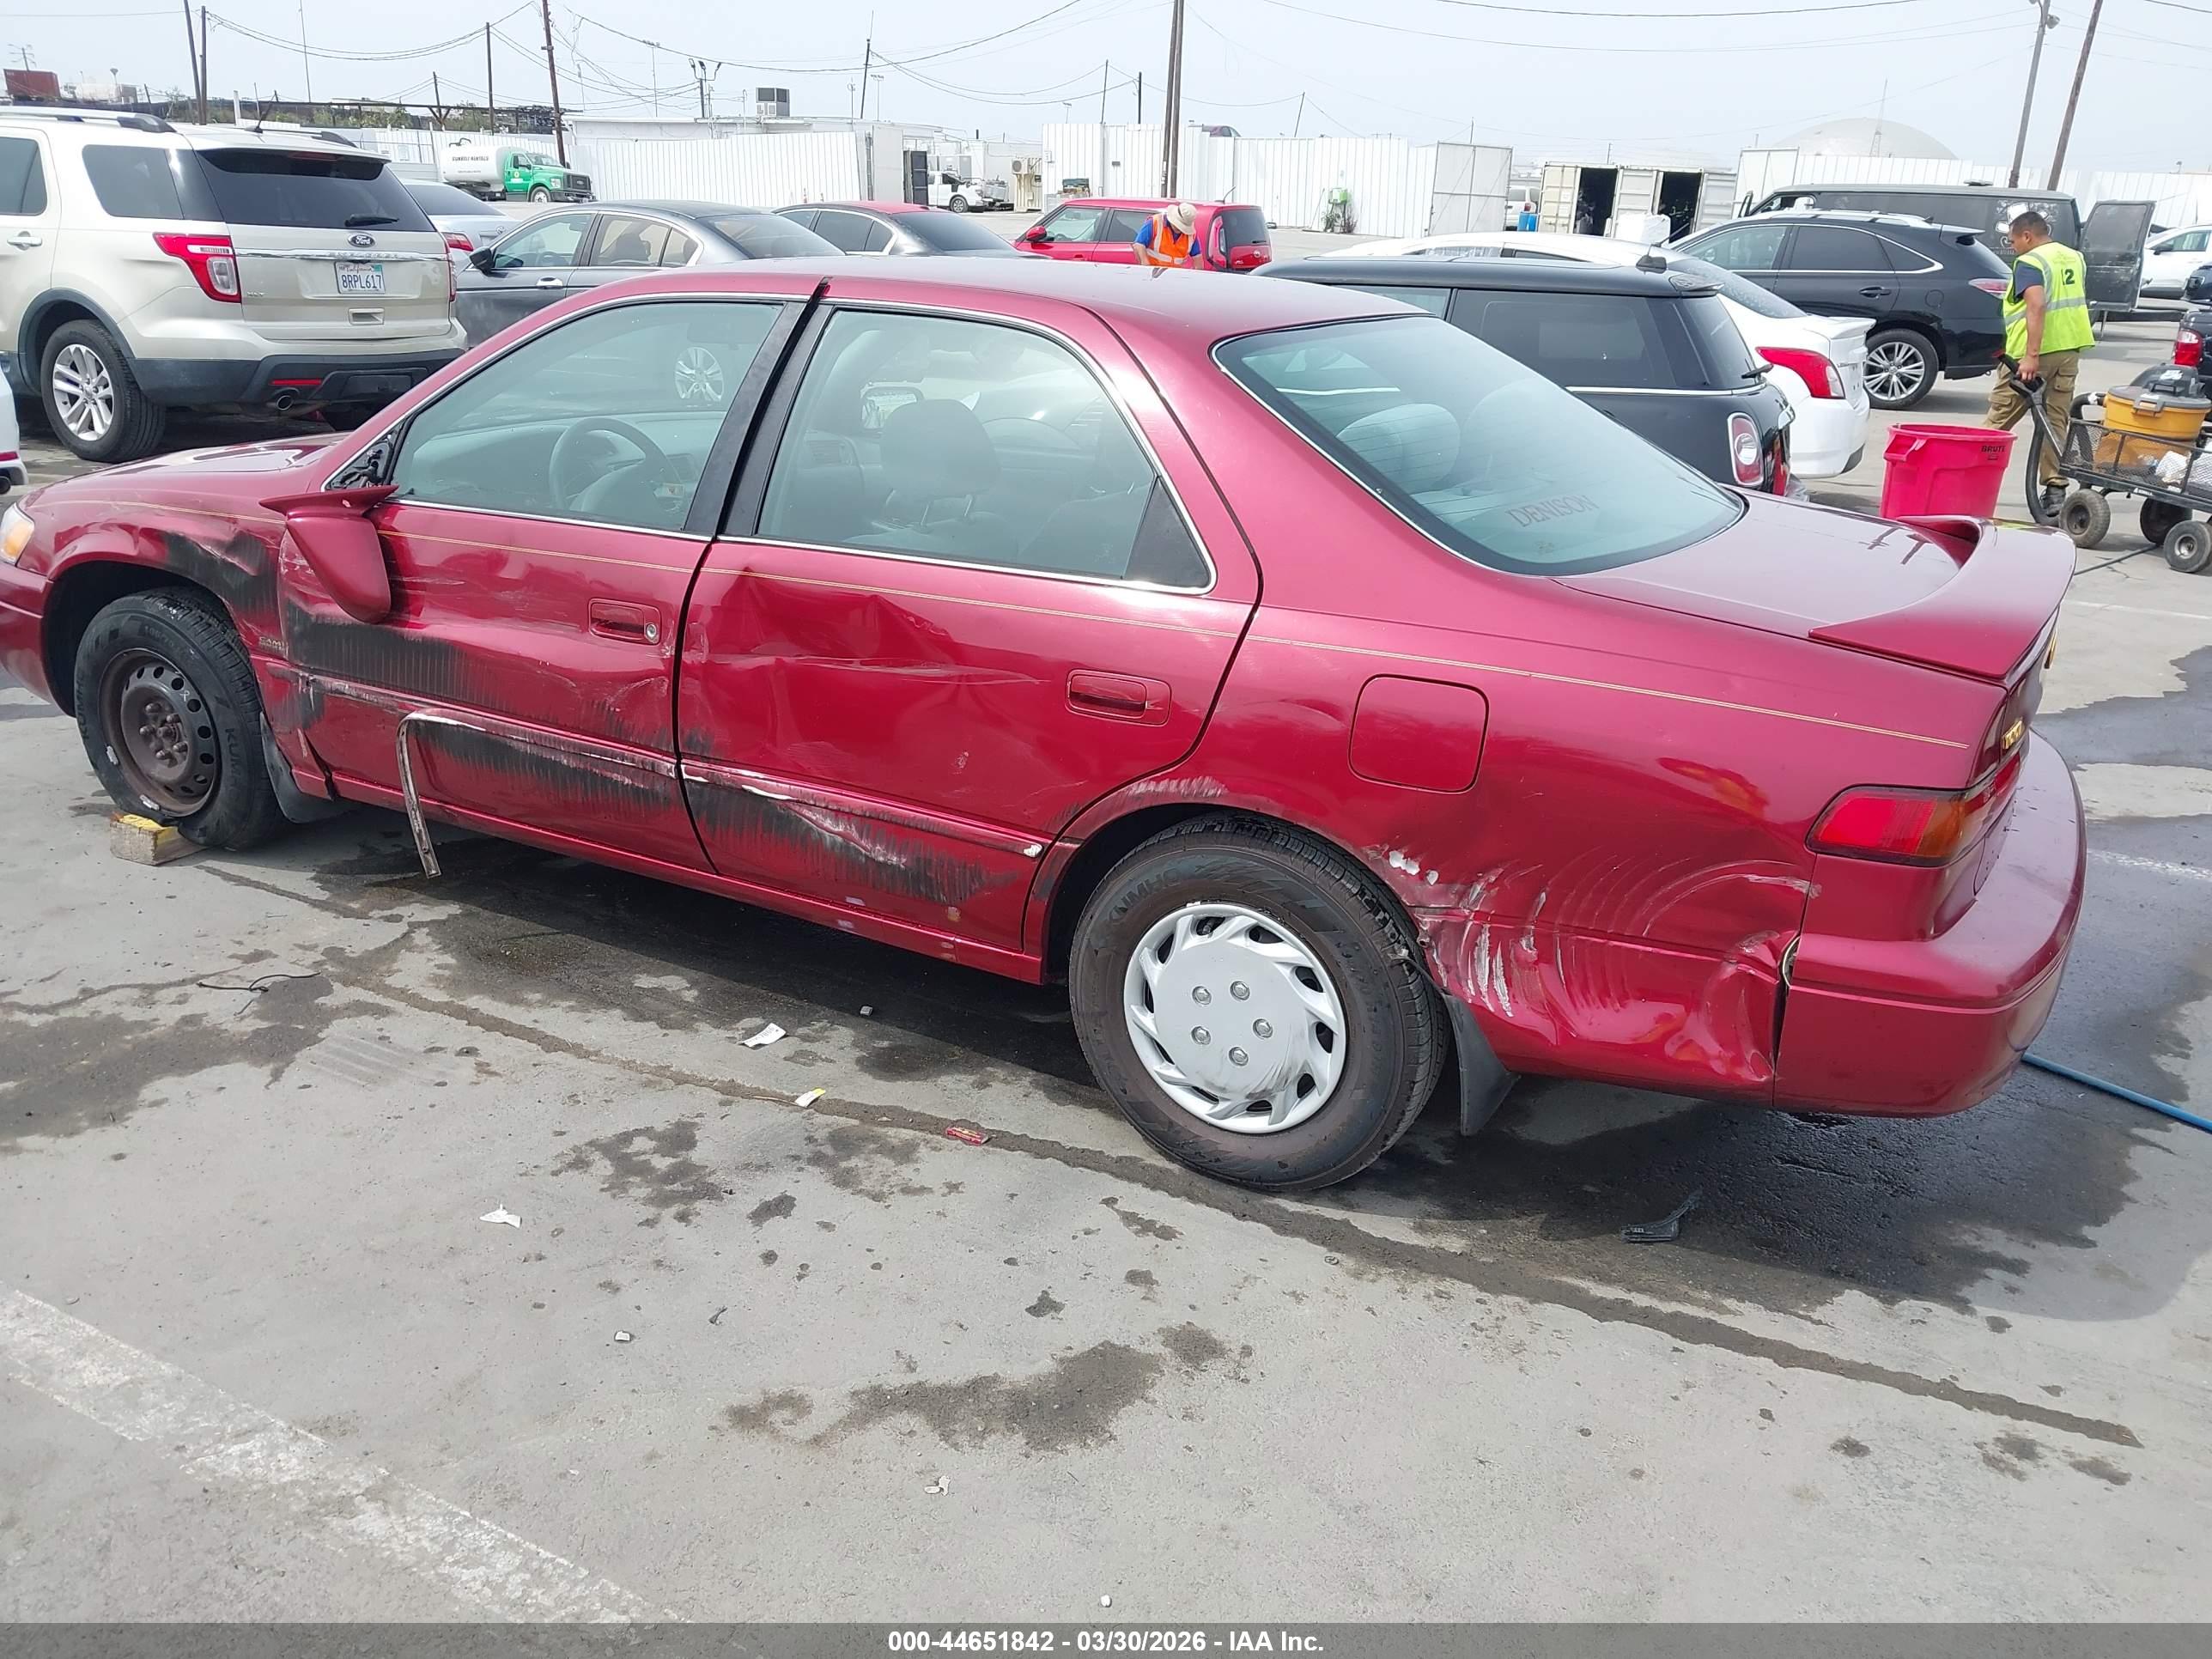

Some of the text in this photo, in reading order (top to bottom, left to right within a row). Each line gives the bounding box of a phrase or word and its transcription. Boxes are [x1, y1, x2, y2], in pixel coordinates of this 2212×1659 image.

[356, 234, 371, 245] Ford
[342, 274, 382, 289] 8RPL617
[1504, 495, 1600, 527] DENISON
